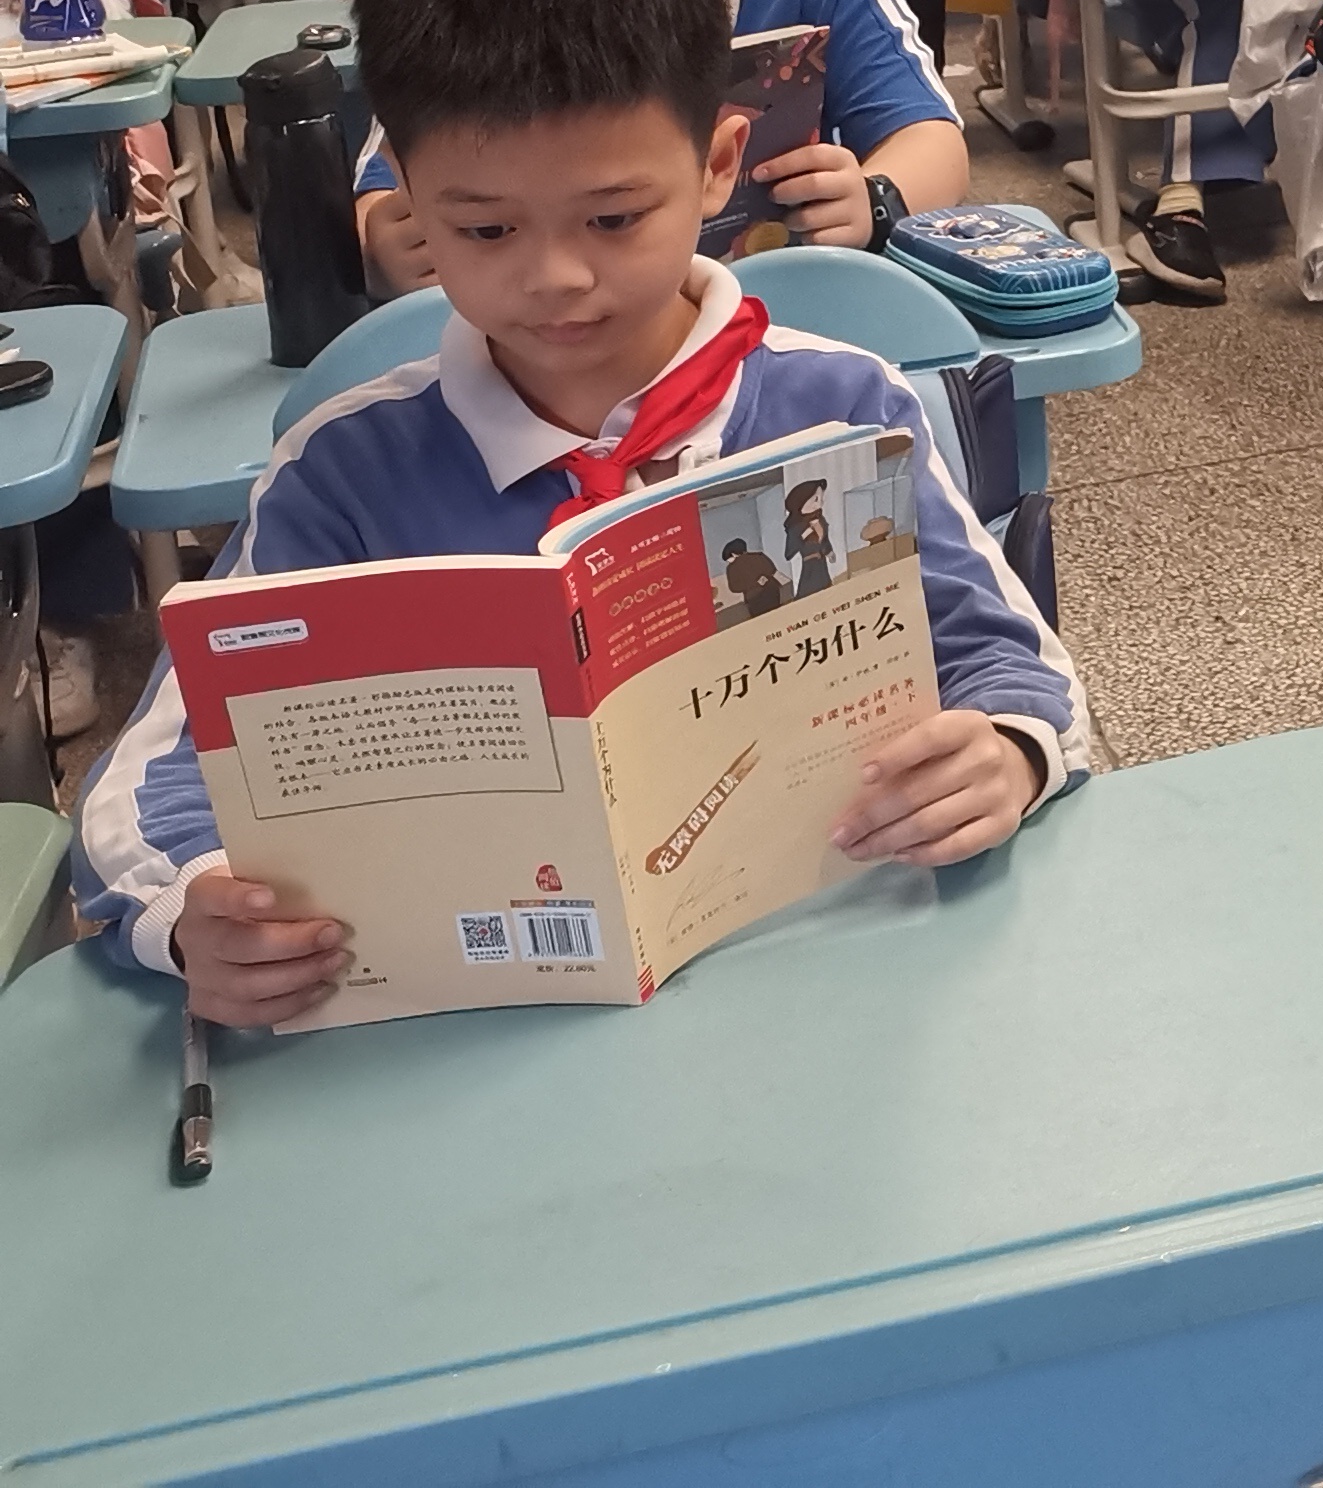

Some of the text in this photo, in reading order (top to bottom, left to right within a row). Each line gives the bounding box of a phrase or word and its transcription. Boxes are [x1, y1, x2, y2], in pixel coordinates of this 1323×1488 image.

[855, 590, 881, 605] SHEN
[679, 607, 905, 720] 十万个为什么
[652, 772, 739, 875] 无障碍阅读
